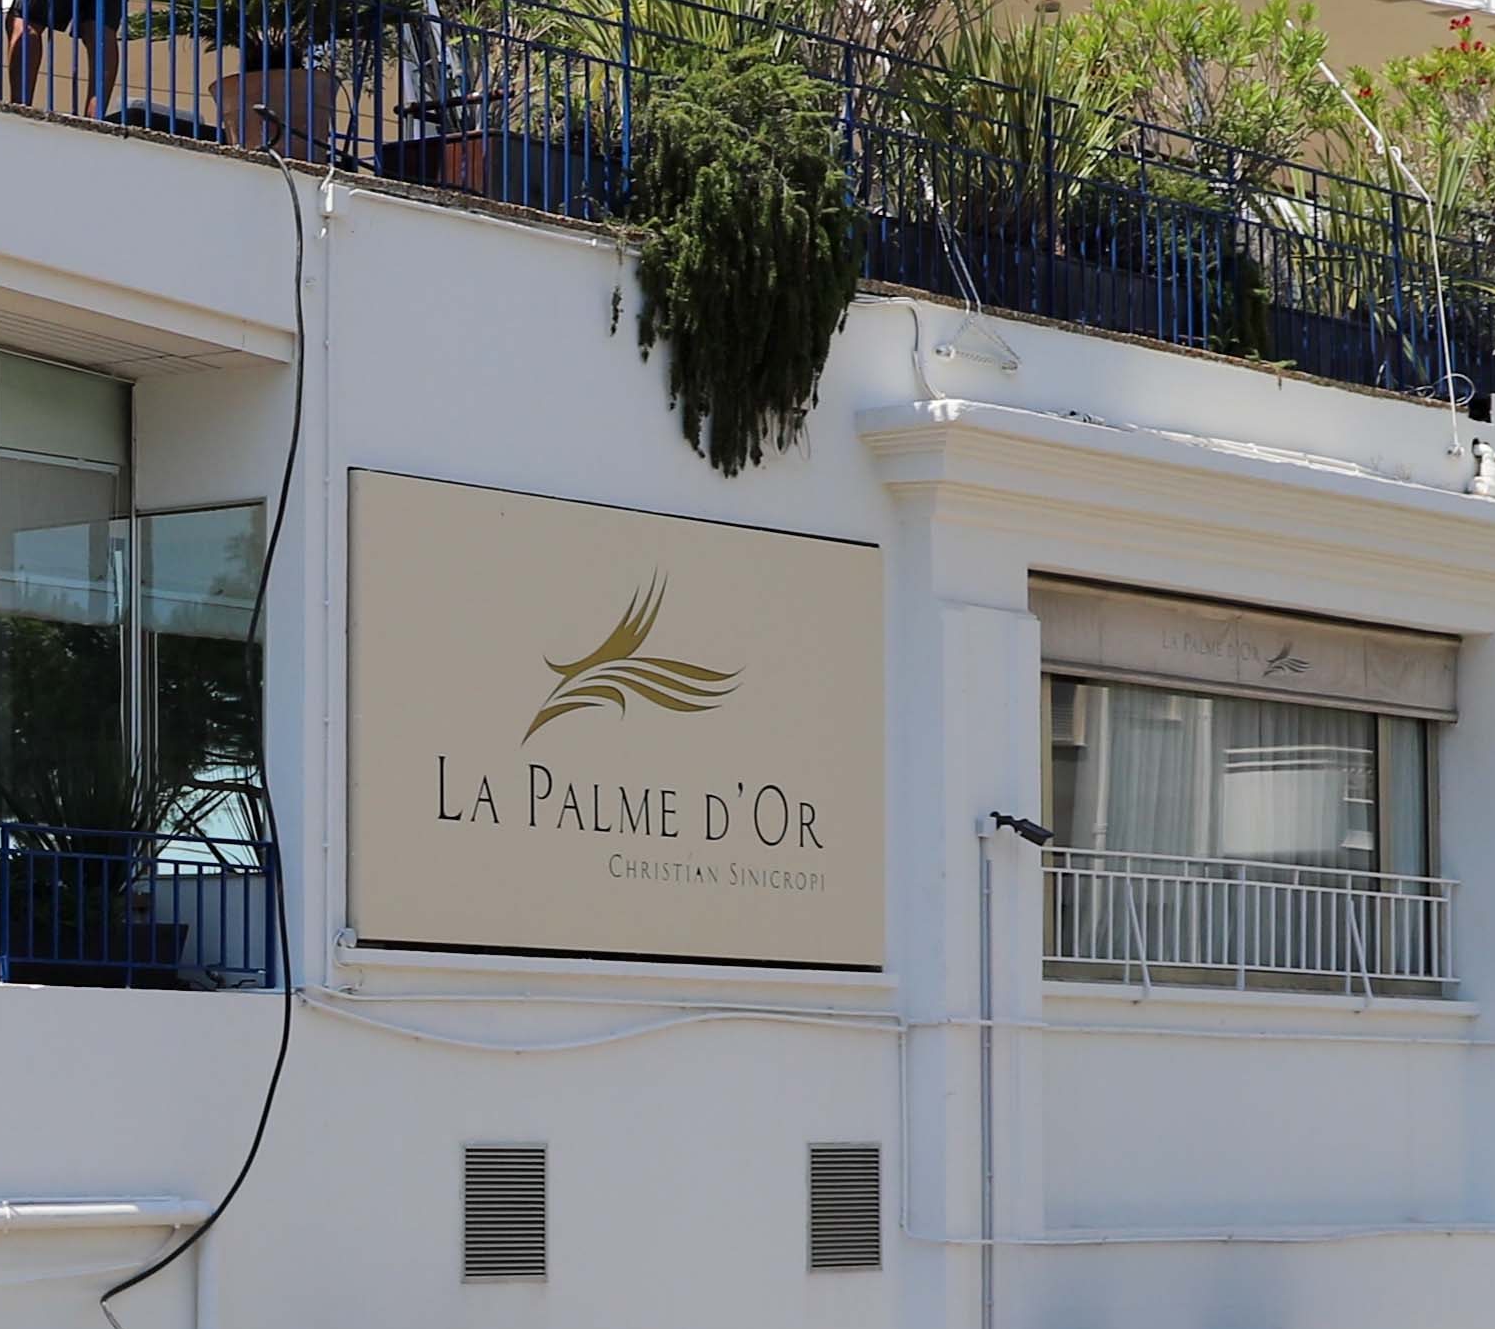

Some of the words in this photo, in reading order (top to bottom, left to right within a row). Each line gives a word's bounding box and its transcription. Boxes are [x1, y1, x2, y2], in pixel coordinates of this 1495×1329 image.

[528, 763, 679, 838] PALME
[608, 853, 719, 885] CHRISTIAN
[729, 861, 826, 892] SINICROPI
